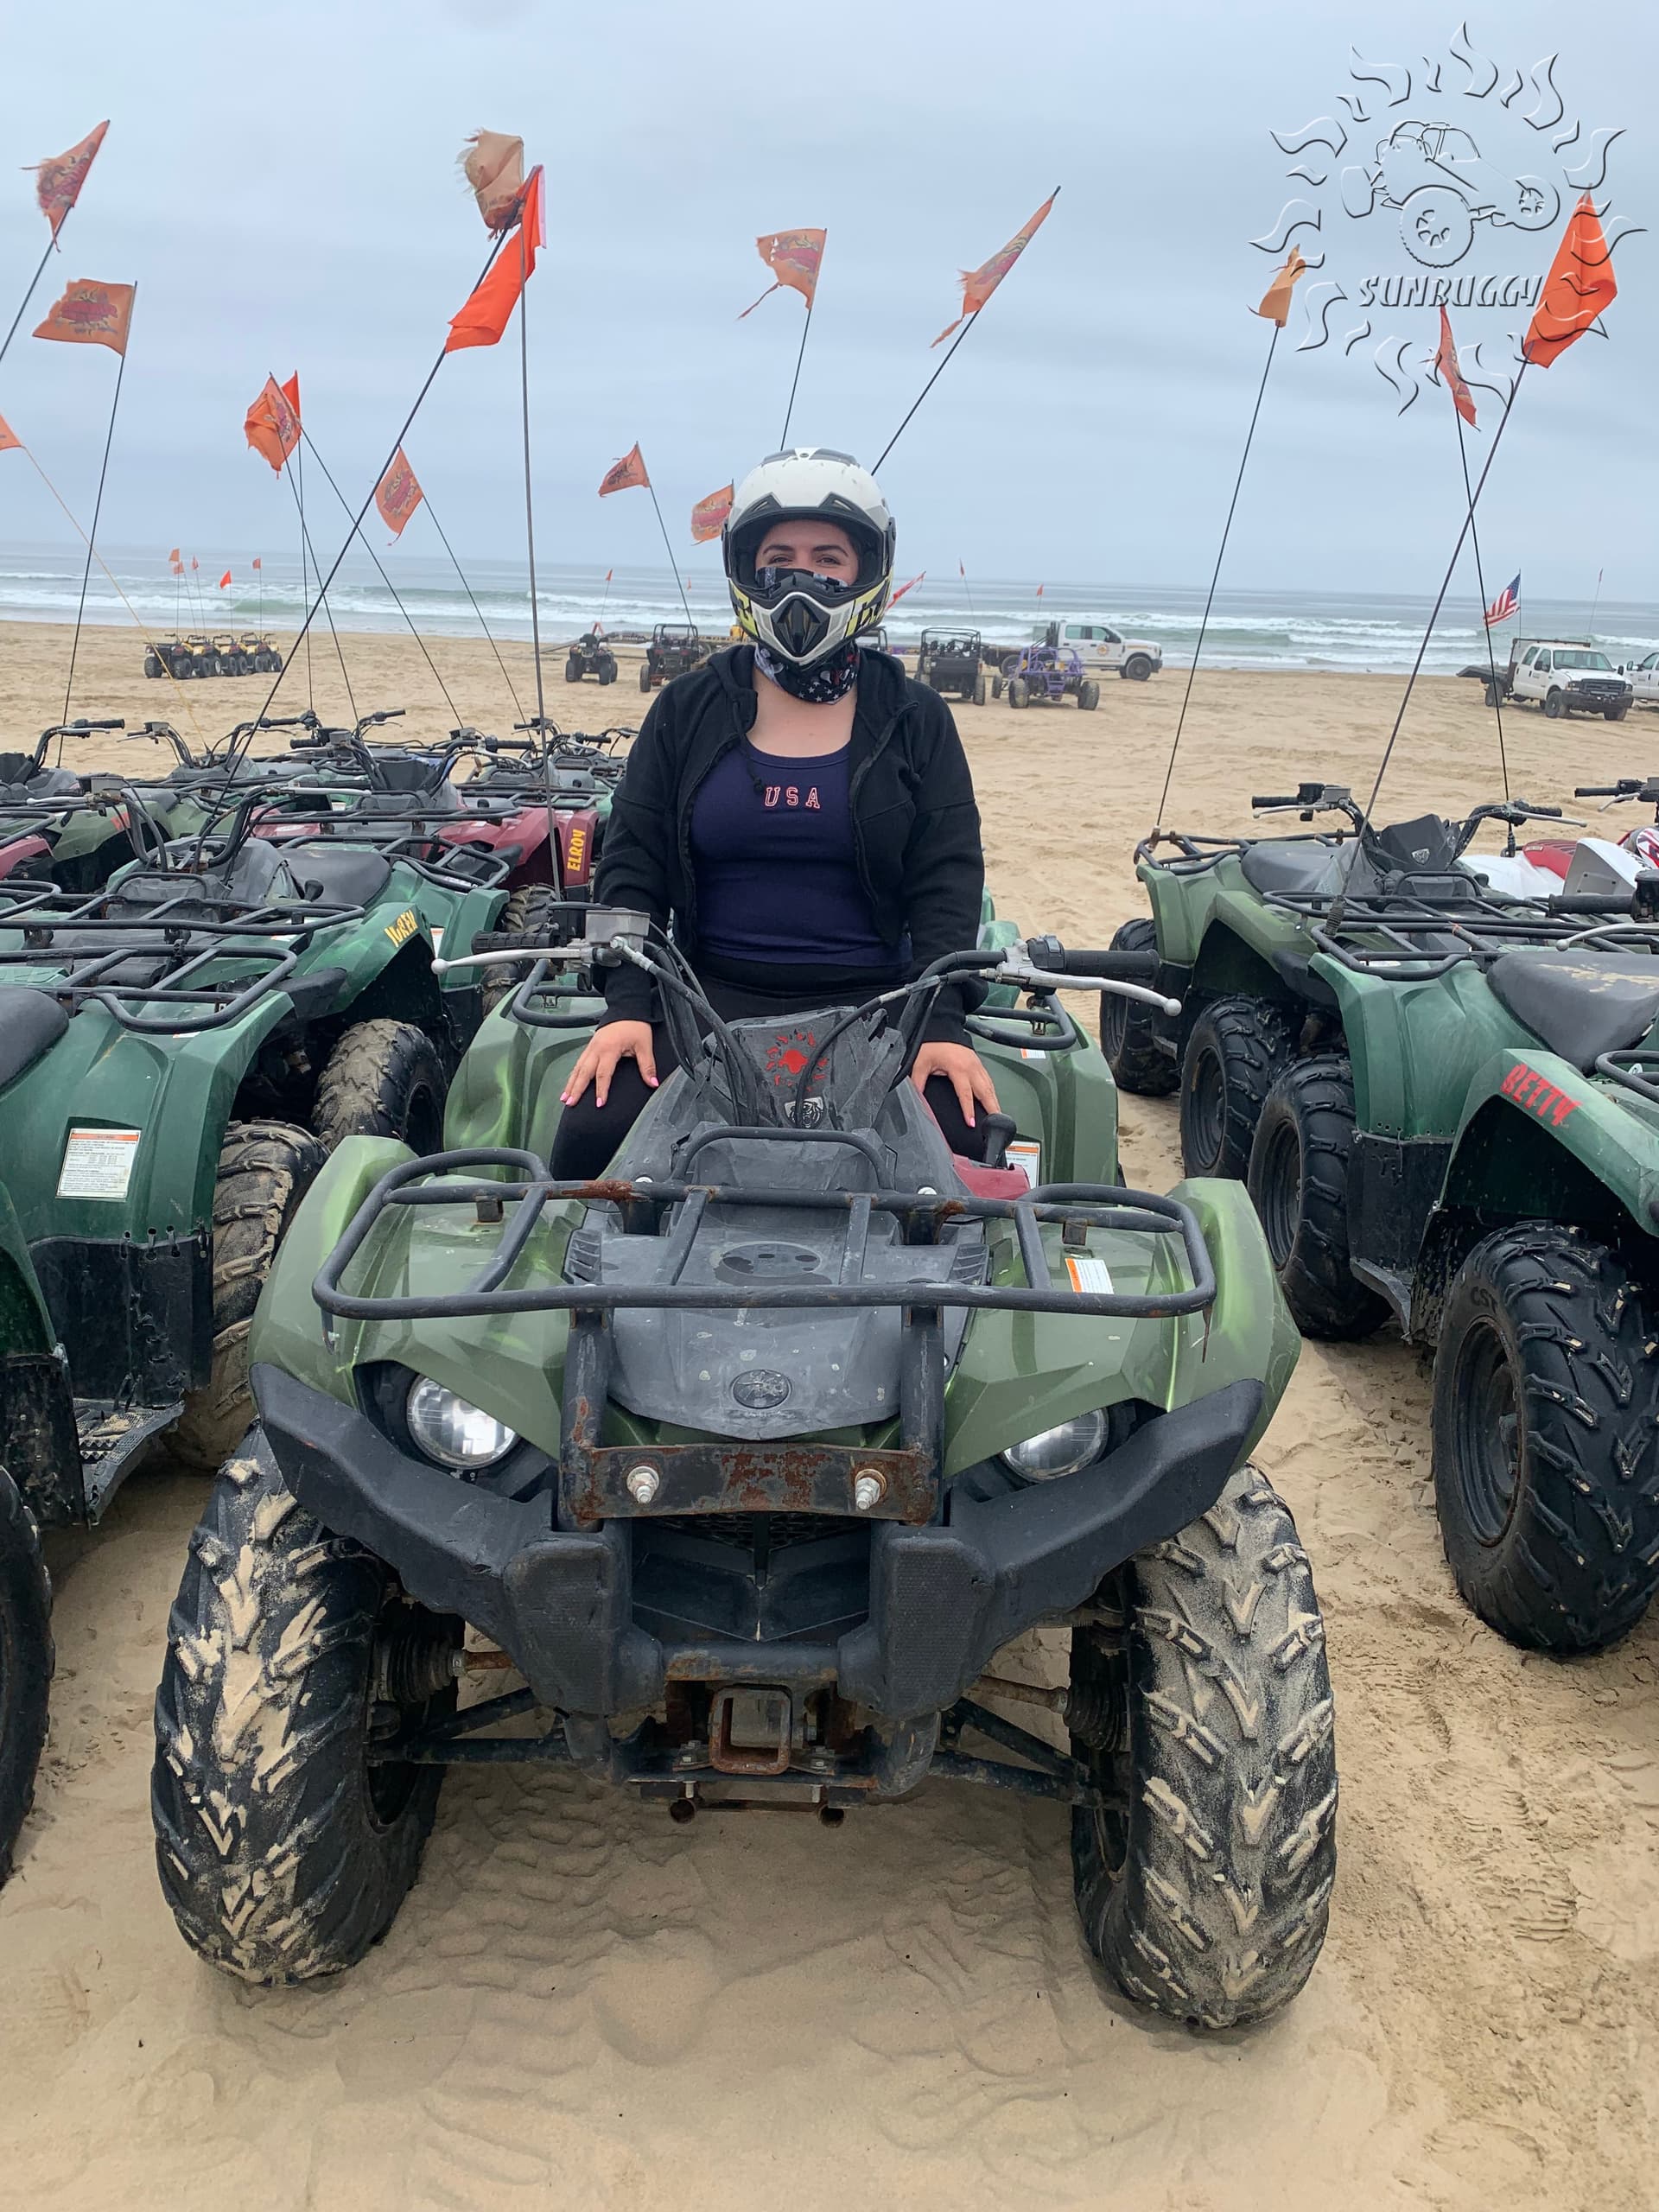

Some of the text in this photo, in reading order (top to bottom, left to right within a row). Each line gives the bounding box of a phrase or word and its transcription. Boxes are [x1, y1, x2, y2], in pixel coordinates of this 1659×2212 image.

[764, 785, 821, 810] USA
[567, 829, 587, 871] ELROY
[1500, 1063, 1583, 1126] BETTY
